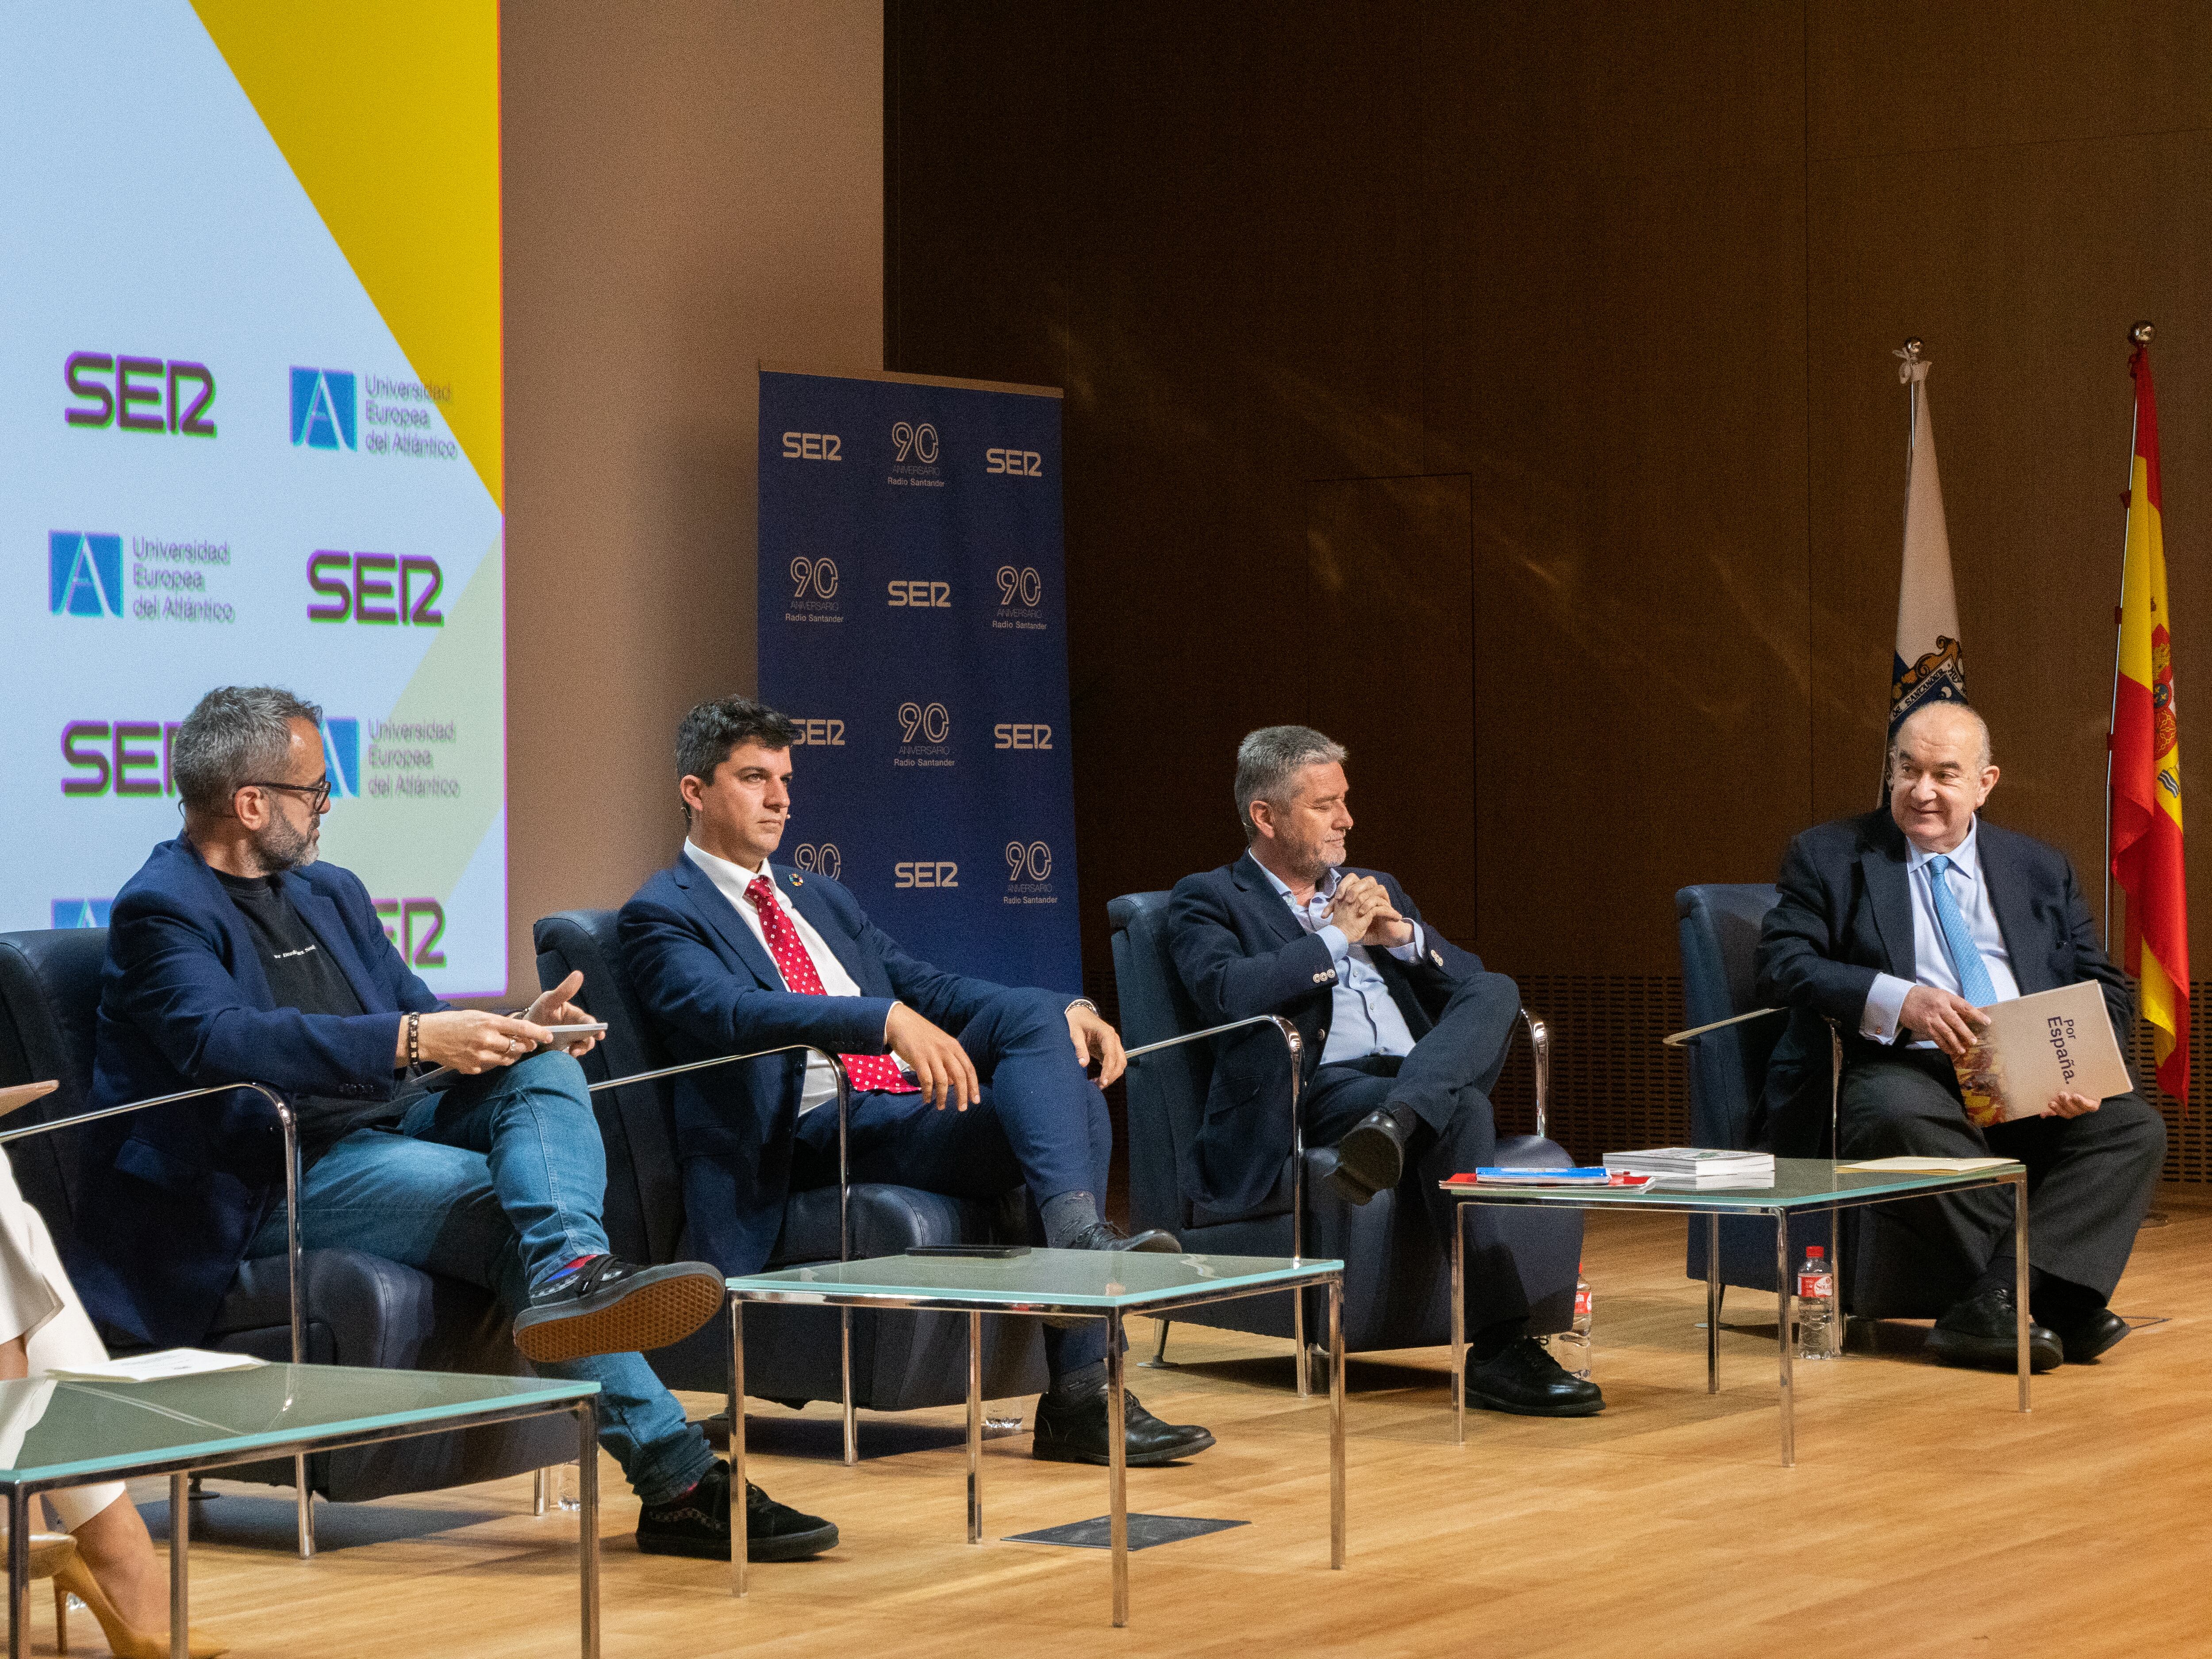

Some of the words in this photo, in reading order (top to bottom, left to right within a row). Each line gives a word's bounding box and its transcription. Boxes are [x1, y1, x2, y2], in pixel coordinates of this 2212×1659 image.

[64, 350, 218, 436] SER
[365, 374, 453, 403] Universidad
[365, 399, 431, 430] Europea
[365, 430, 391, 455] del
[392, 431, 459, 461] Atlántico
[783, 432, 841, 461] SER
[892, 421, 938, 463] 90
[892, 465, 941, 476] ANIVERSARIO
[986, 448, 1042, 477] SER
[888, 477, 908, 485] Radio
[910, 478, 945, 487] Santander
[133, 535, 231, 566] Universidad
[133, 563, 205, 592] Europea
[306, 549, 445, 627] SER
[790, 556, 838, 599] 90
[997, 565, 1041, 607] 90
[790, 601, 839, 611] ANIVERSARIO
[887, 580, 951, 607] SER
[133, 595, 159, 621] del
[162, 596, 236, 624] Atlántico
[785, 613, 806, 621] Radio
[808, 614, 844, 622] Santander
[1015, 621, 1048, 630] Santander
[368, 718, 457, 744] Universidad
[898, 702, 949, 743] 90
[995, 724, 1052, 749] SER
[368, 743, 434, 771] Europea
[894, 758, 915, 766] Radio
[918, 758, 955, 766] Santander
[899, 745, 950, 755] ANIVERSARIO
[368, 774, 393, 798] del
[395, 774, 461, 798] Atlántico
[795, 843, 841, 881] 90
[895, 861, 959, 888] SER
[1006, 841, 1052, 881] 90
[1007, 883, 1053, 893] ANIVERSARIO
[2063, 1019, 2076, 1040] Por
[2047, 1016, 2075, 1084] España.
